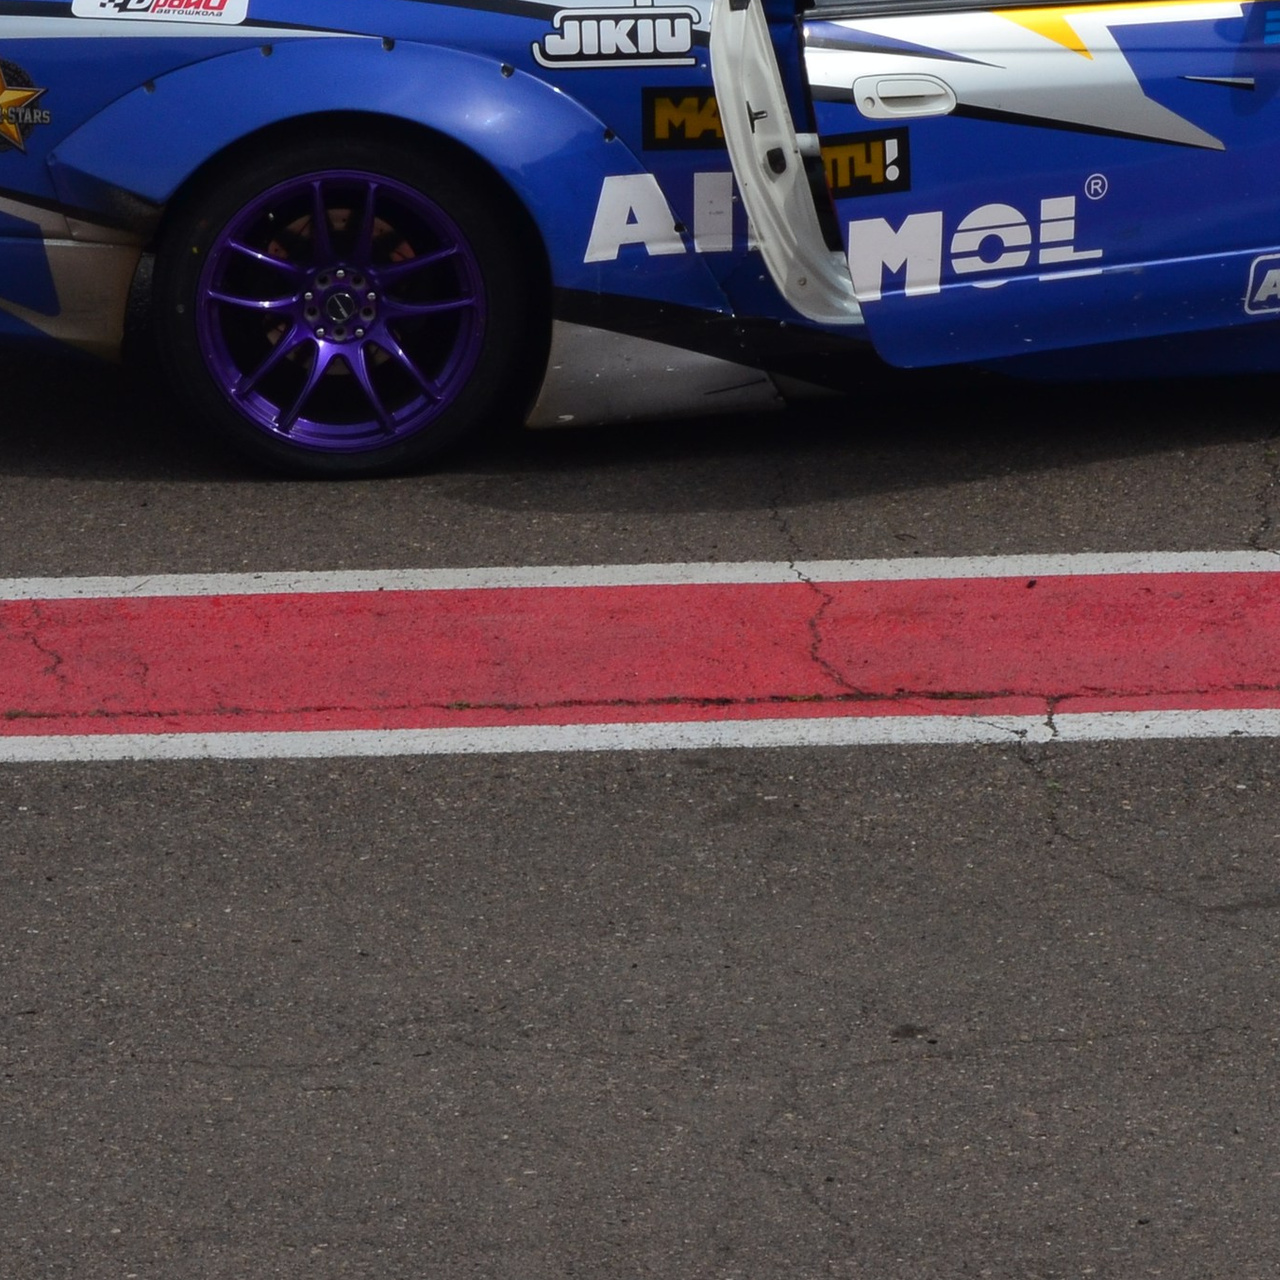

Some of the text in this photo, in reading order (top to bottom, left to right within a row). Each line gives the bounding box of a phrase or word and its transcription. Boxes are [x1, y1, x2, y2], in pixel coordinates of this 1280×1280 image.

[156, 7, 224, 18] автошкола
[544, 17, 692, 56] JIKIU
[822, 138, 900, 189] ТЧ!
[583, 171, 765, 263] AI
